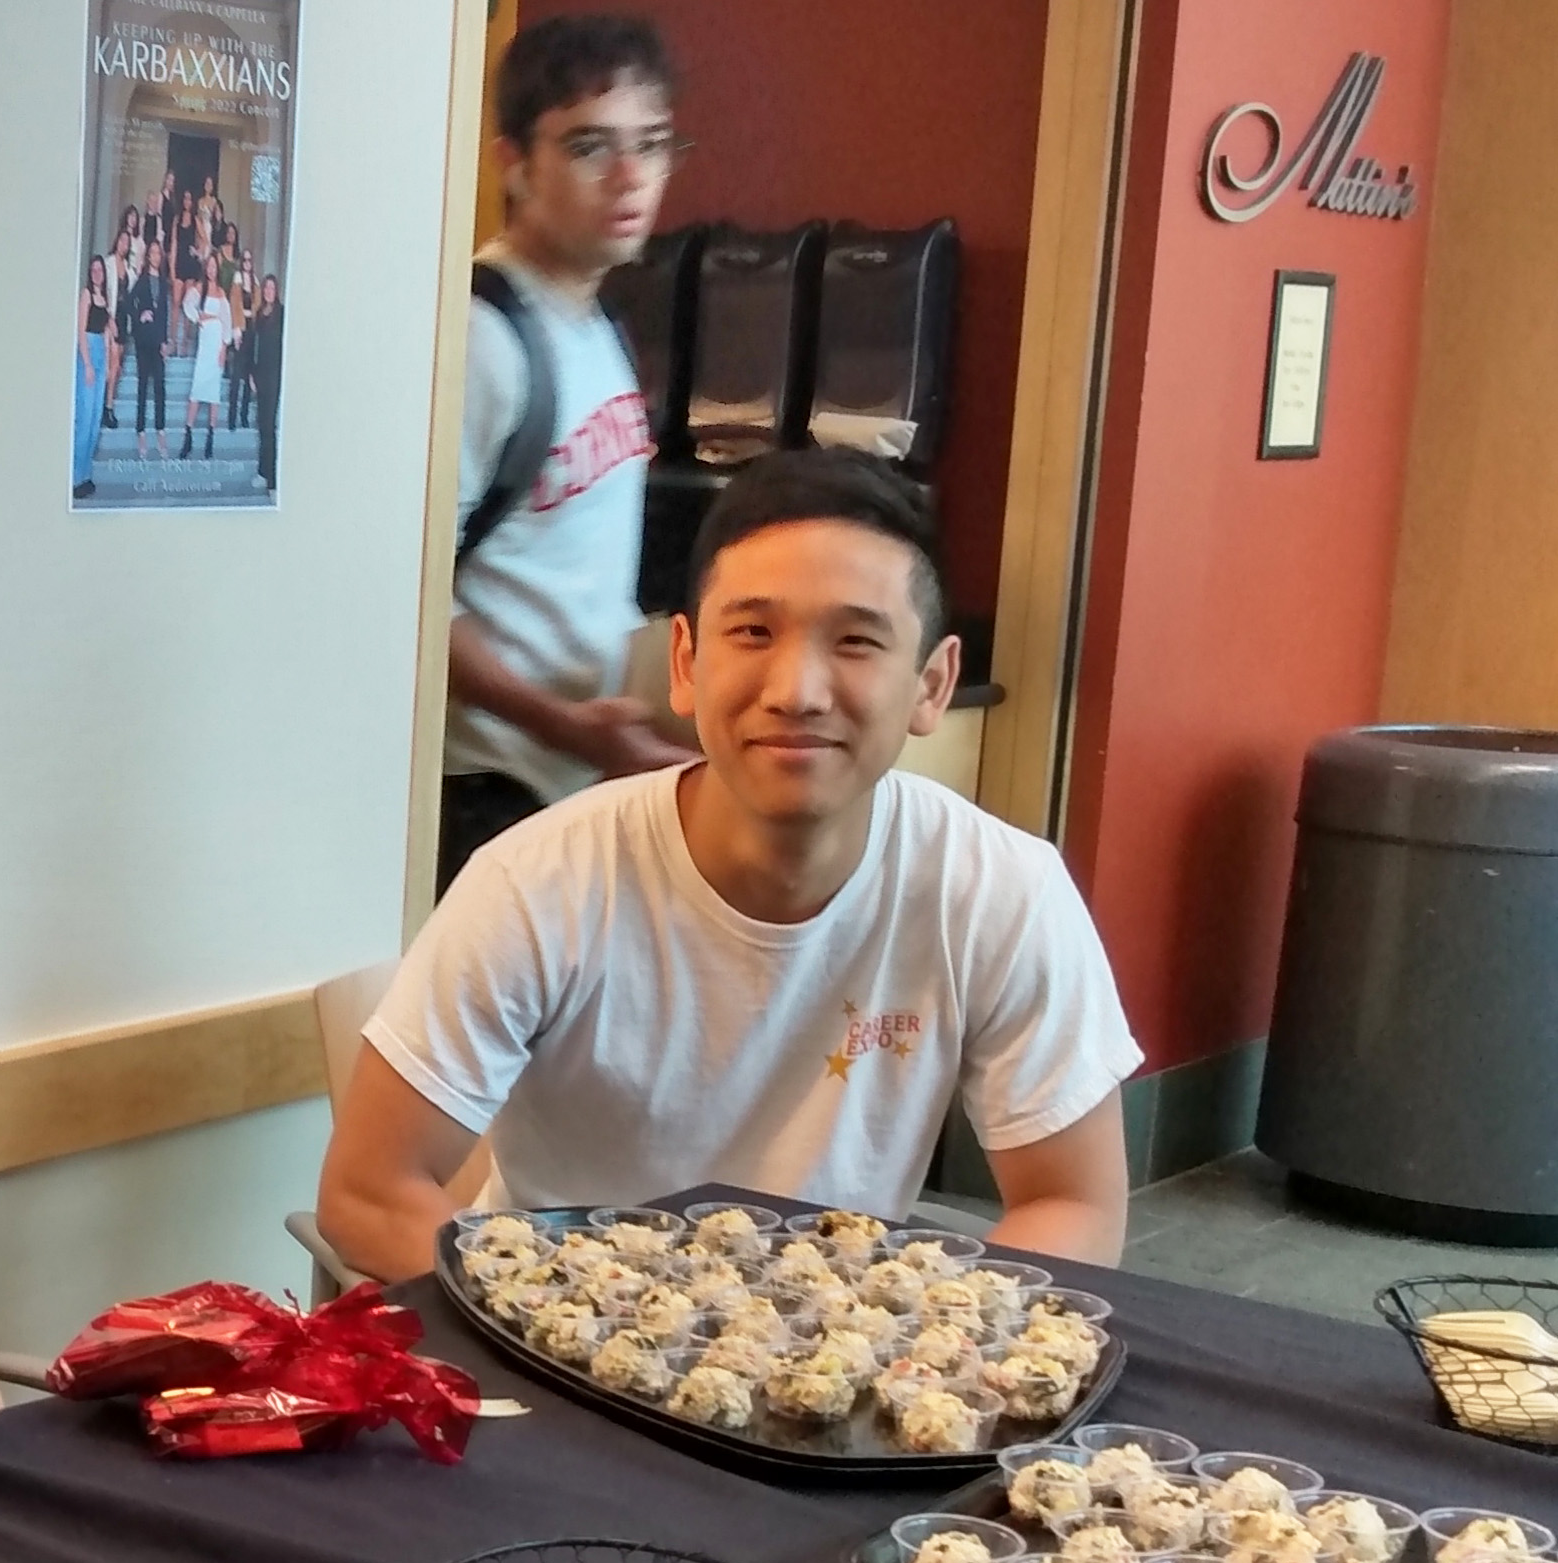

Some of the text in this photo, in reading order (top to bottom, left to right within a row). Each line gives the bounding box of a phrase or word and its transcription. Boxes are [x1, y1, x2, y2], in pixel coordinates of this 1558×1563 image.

[113, 21, 275, 58] KEEPING UP WITH THE
[94, 34, 291, 101] KARBAXXIANS
